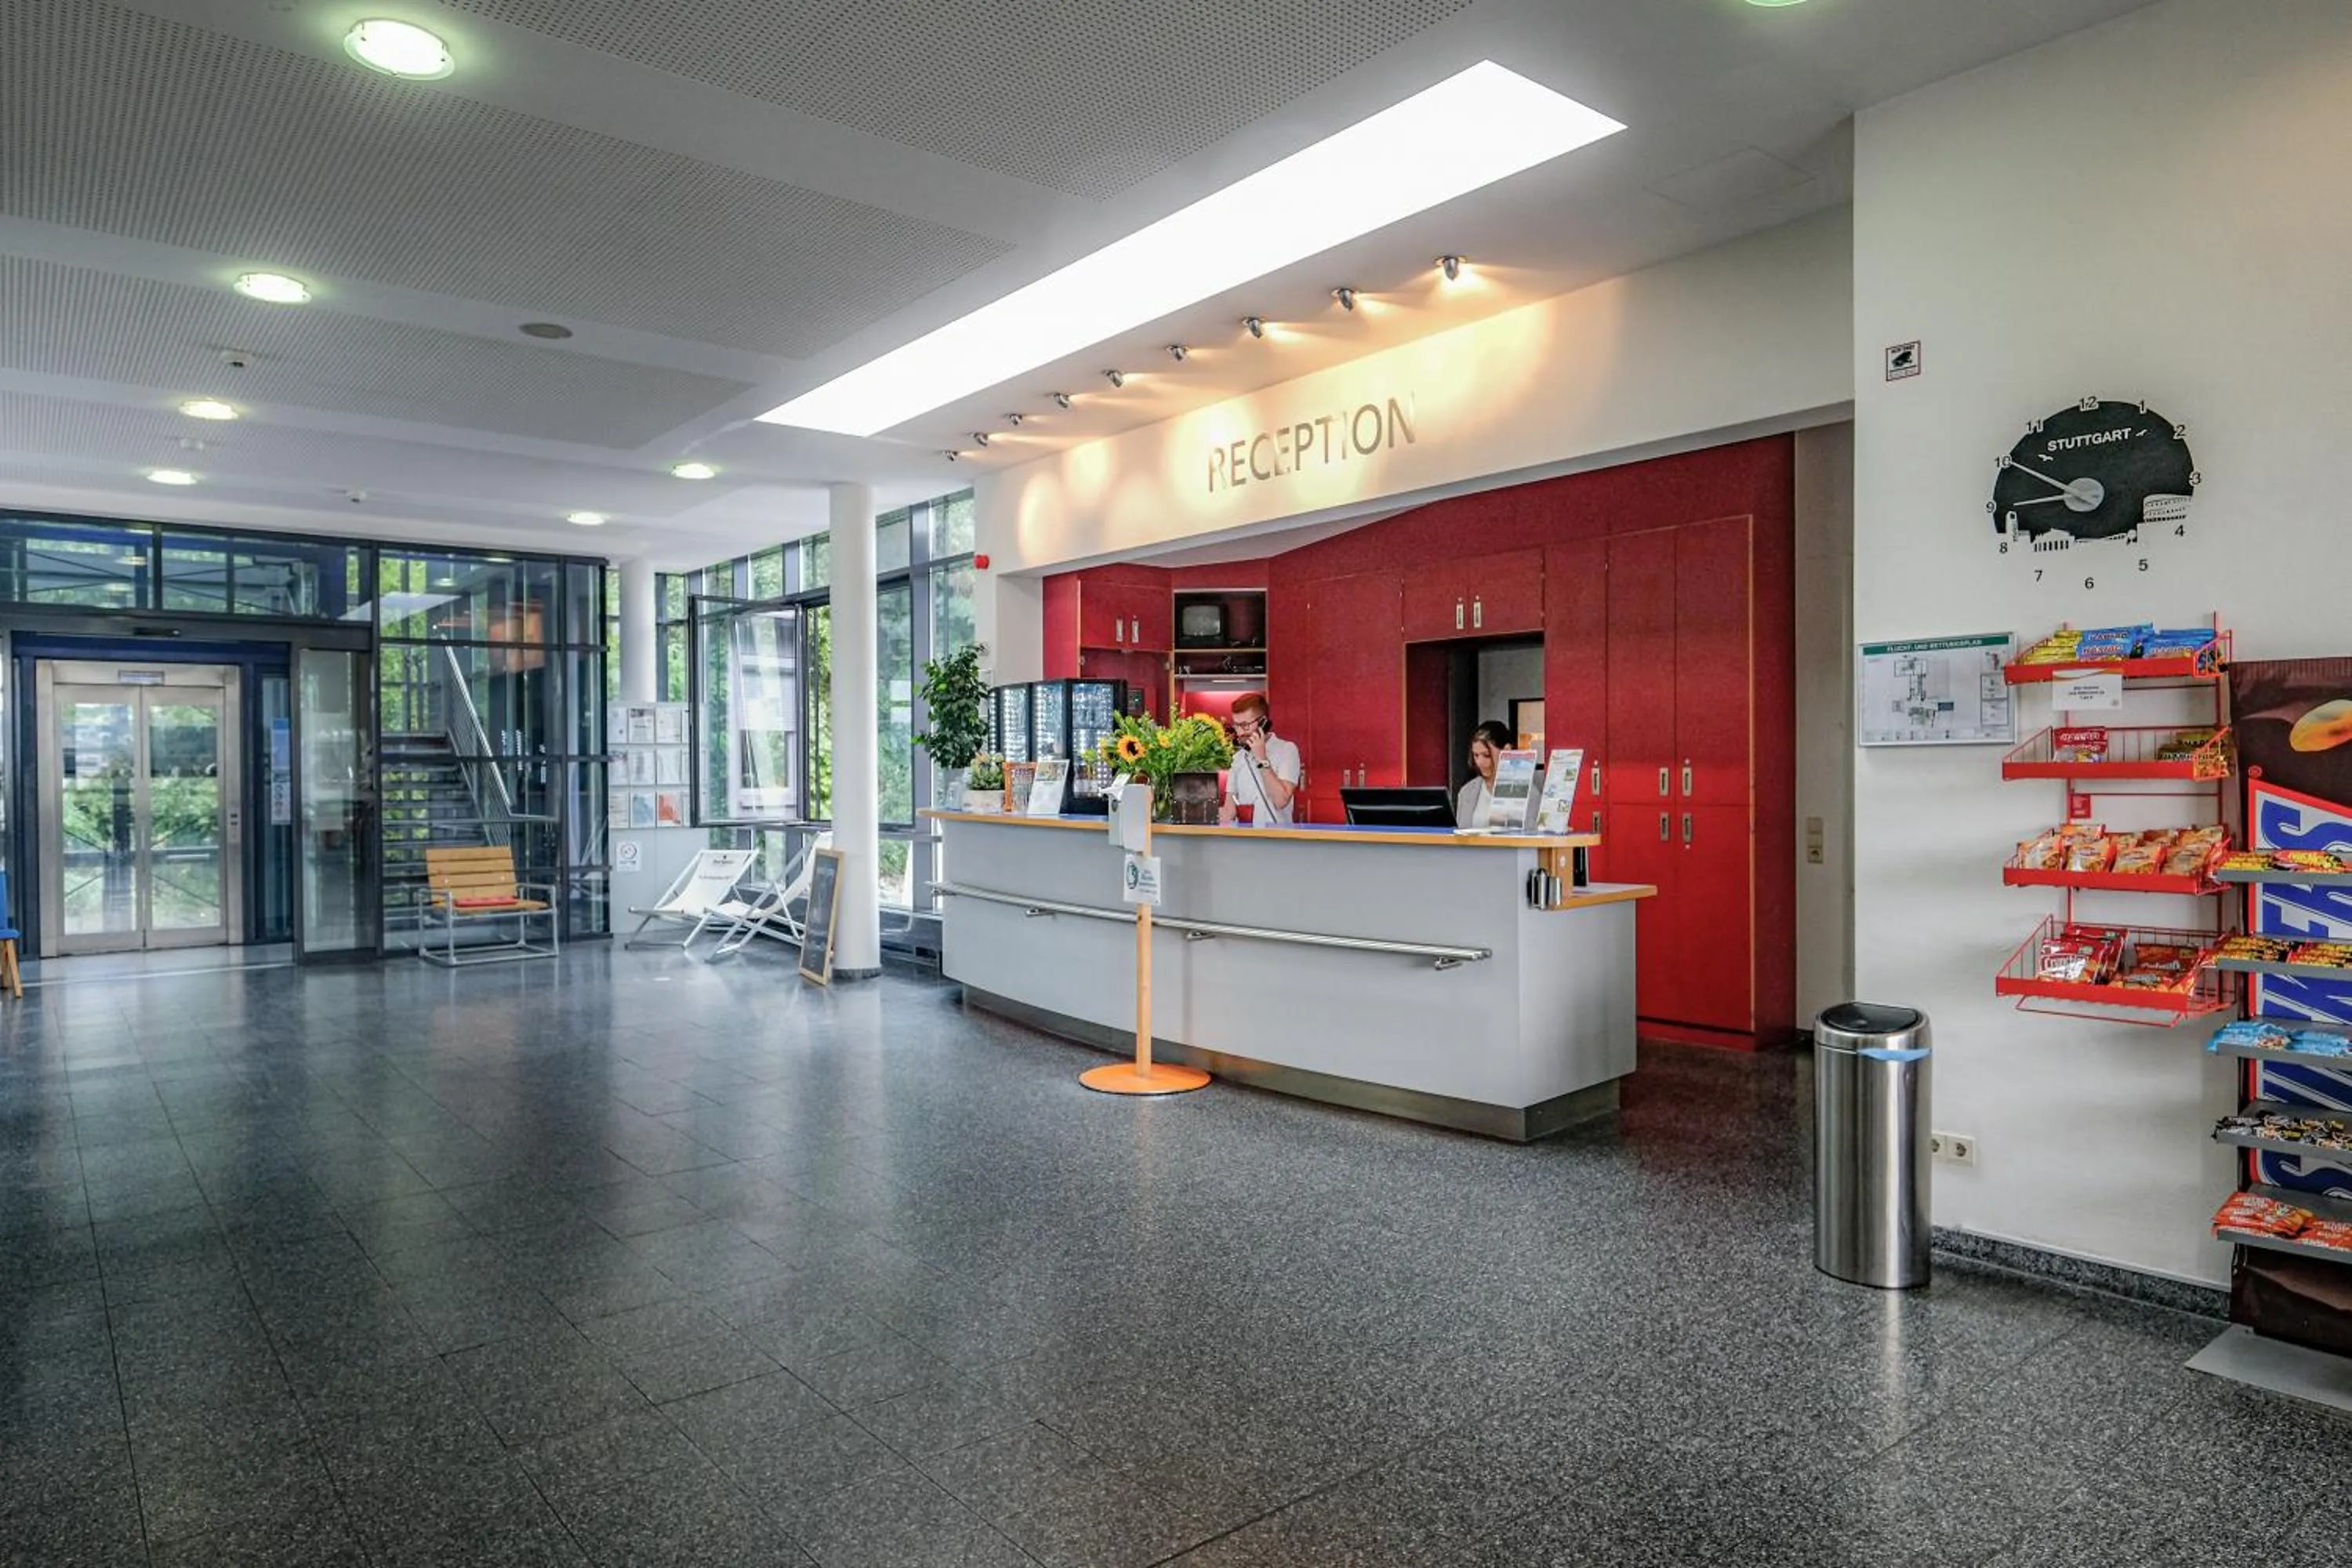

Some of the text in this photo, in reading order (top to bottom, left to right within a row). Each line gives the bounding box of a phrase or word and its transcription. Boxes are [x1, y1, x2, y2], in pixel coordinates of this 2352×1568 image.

[2079, 396, 2098, 410] 12
[2026, 419, 2043, 433] 11
[2174, 424, 2186, 437] 2
[1208, 390, 1415, 492] RECEPTION
[2047, 427, 2132, 452] STUTTGART
[1994, 455, 2012, 468] 10
[2190, 471, 2201, 485] 3
[1986, 501, 1995, 514] 9
[2174, 524, 2185, 537] 4
[1999, 542, 2008, 554] 8
[2138, 559, 2148, 572] 5
[2034, 569, 2043, 582] 7
[2085, 576, 2094, 590] 6
